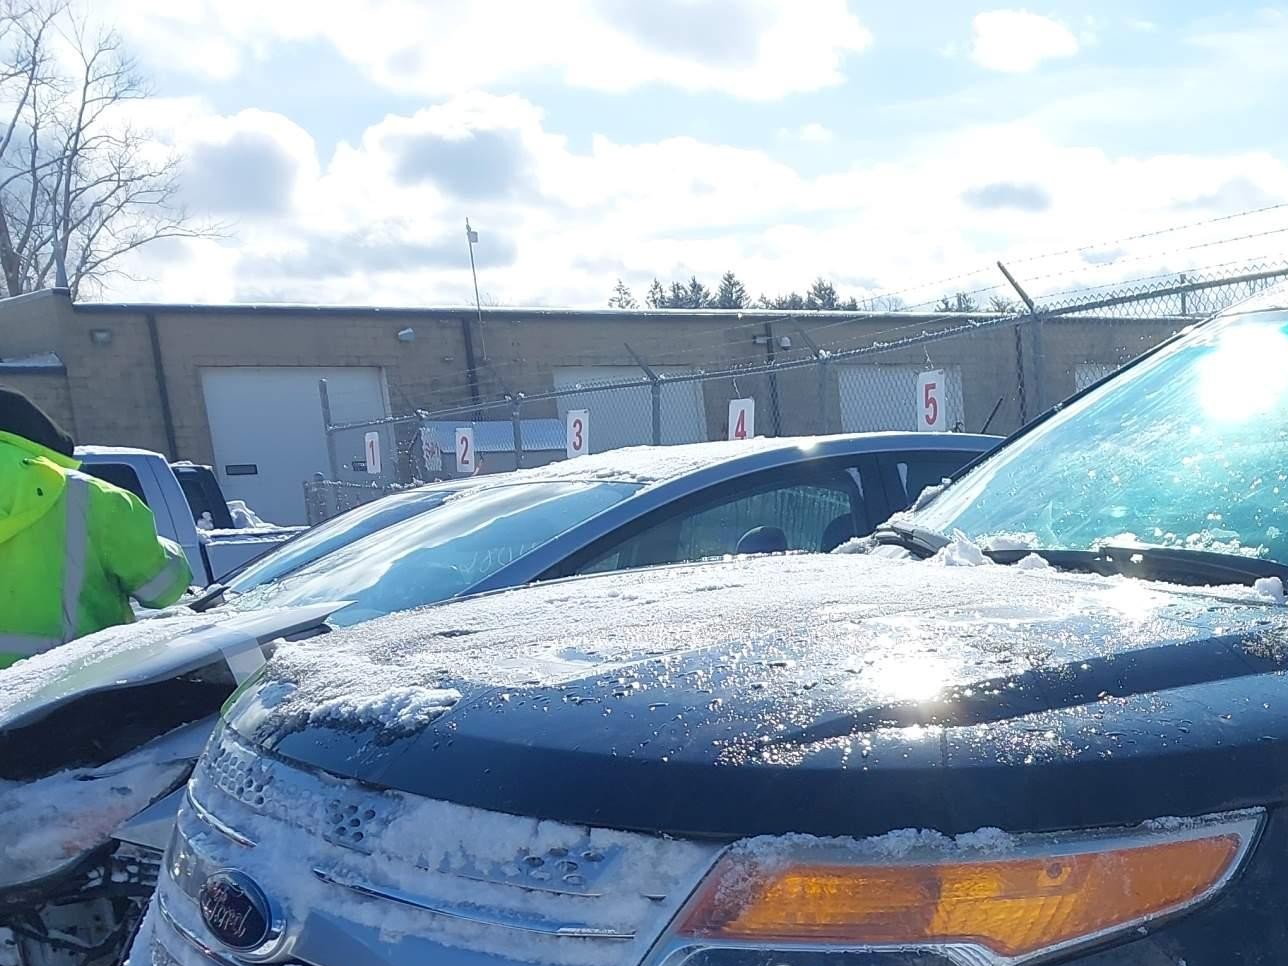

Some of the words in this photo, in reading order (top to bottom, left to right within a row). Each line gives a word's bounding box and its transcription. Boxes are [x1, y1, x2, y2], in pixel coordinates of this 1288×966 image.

[923, 382, 939, 426] 5
[572, 418, 584, 451] 3
[734, 408, 747, 440] 4
[368, 439, 378, 466] 1
[459, 435, 470, 465] 2
